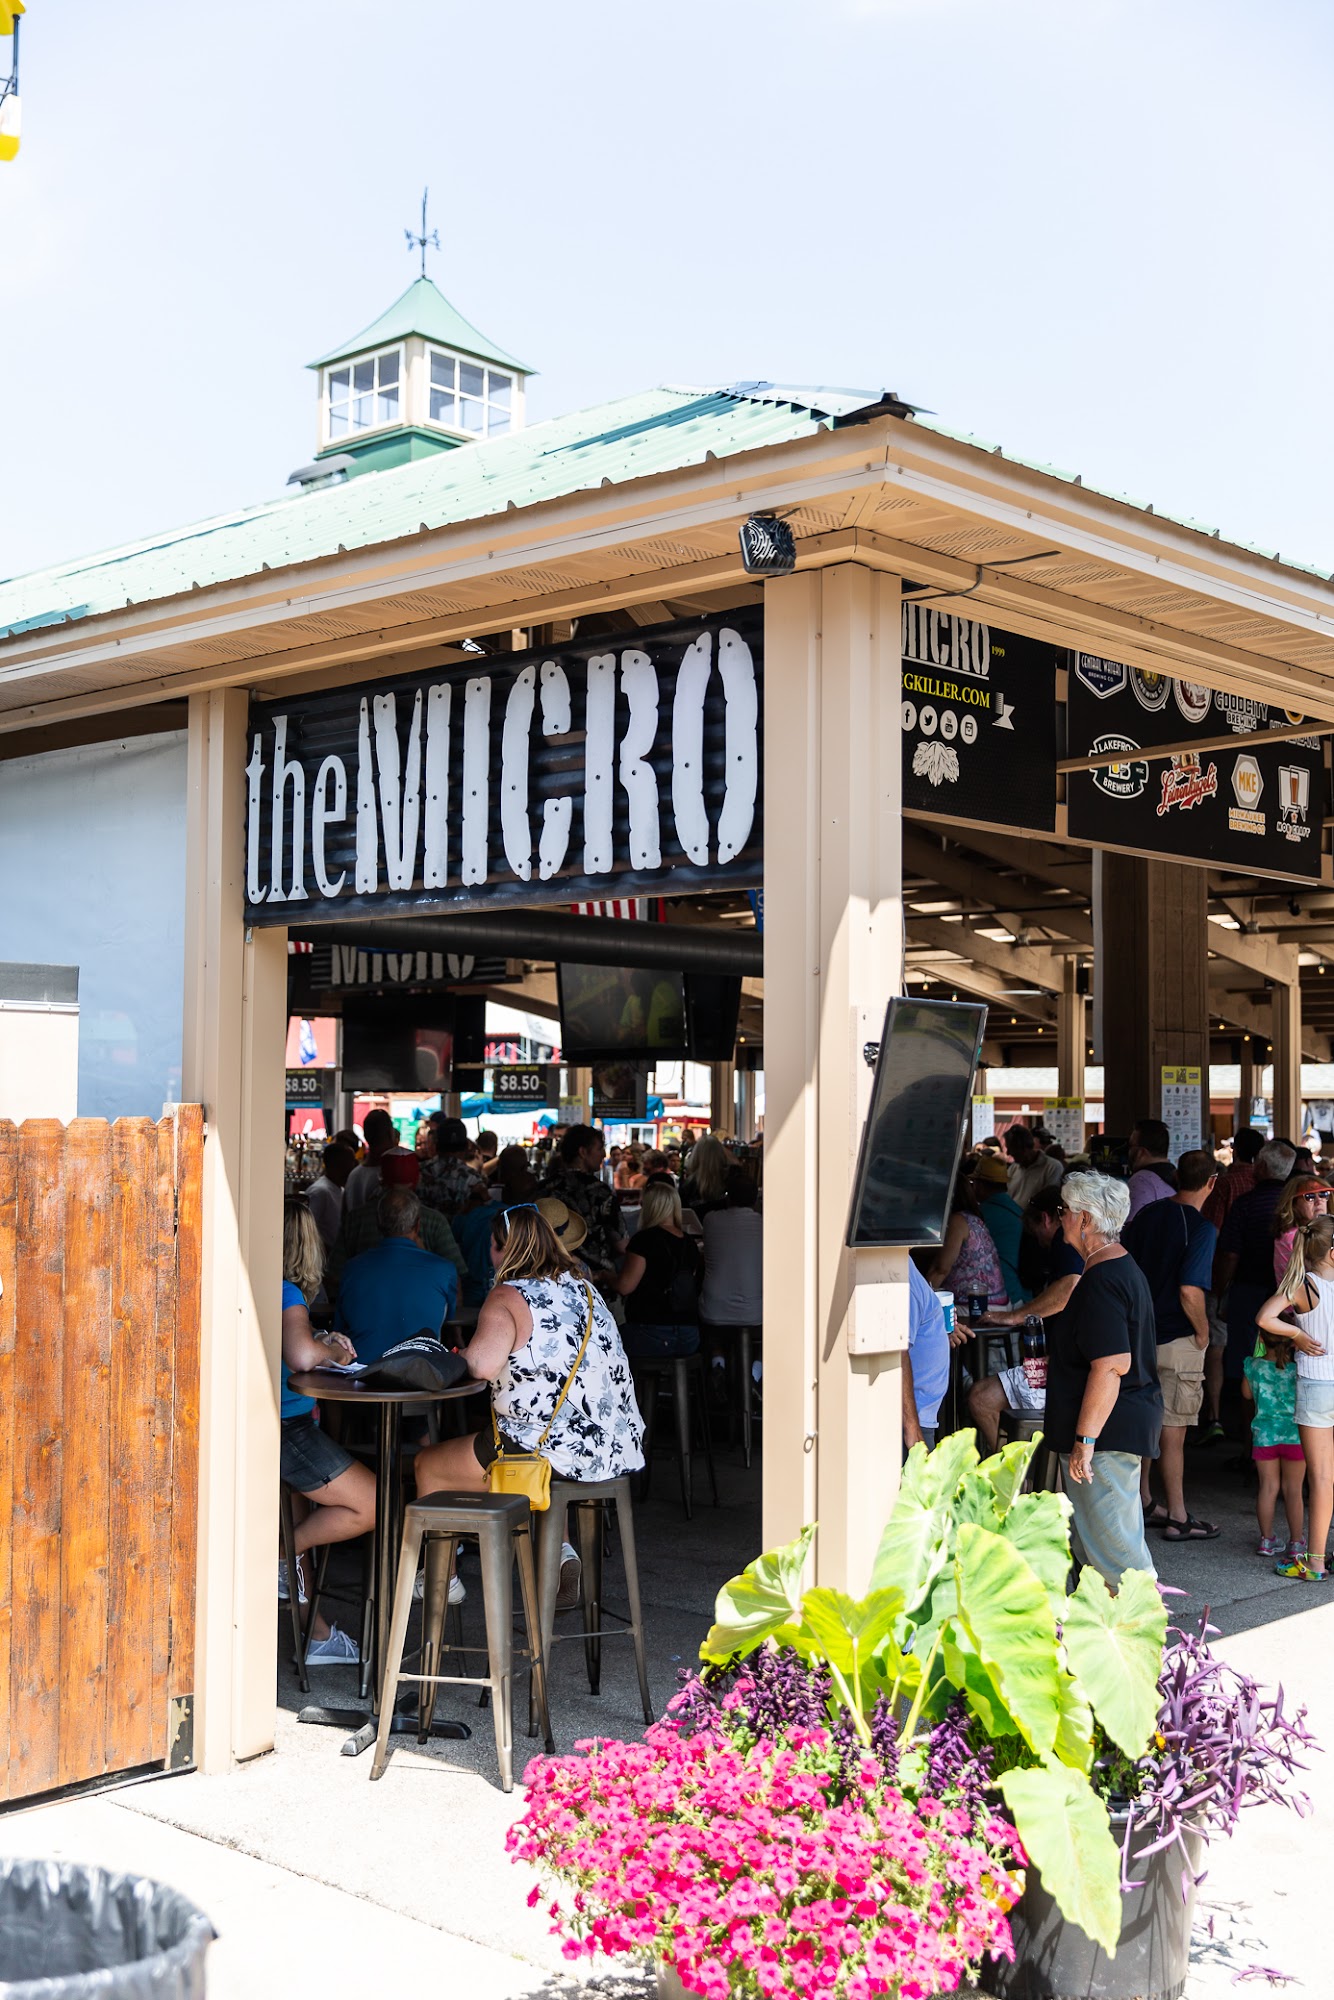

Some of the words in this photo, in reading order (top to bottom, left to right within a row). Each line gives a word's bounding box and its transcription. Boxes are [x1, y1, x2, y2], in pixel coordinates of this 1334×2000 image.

[991, 646, 1005, 657] 1999
[1226, 711, 1257, 730] BREWING
[245, 714, 347, 905] the
[355, 627, 758, 895] MICRO
[1103, 776, 1135, 794] BREWERY
[1238, 771, 1257, 794] MKE
[1229, 807, 1266, 824] MILWAUKEE
[286, 1077, 317, 1093] $8.50
[500, 1074, 540, 1092] $8.50
